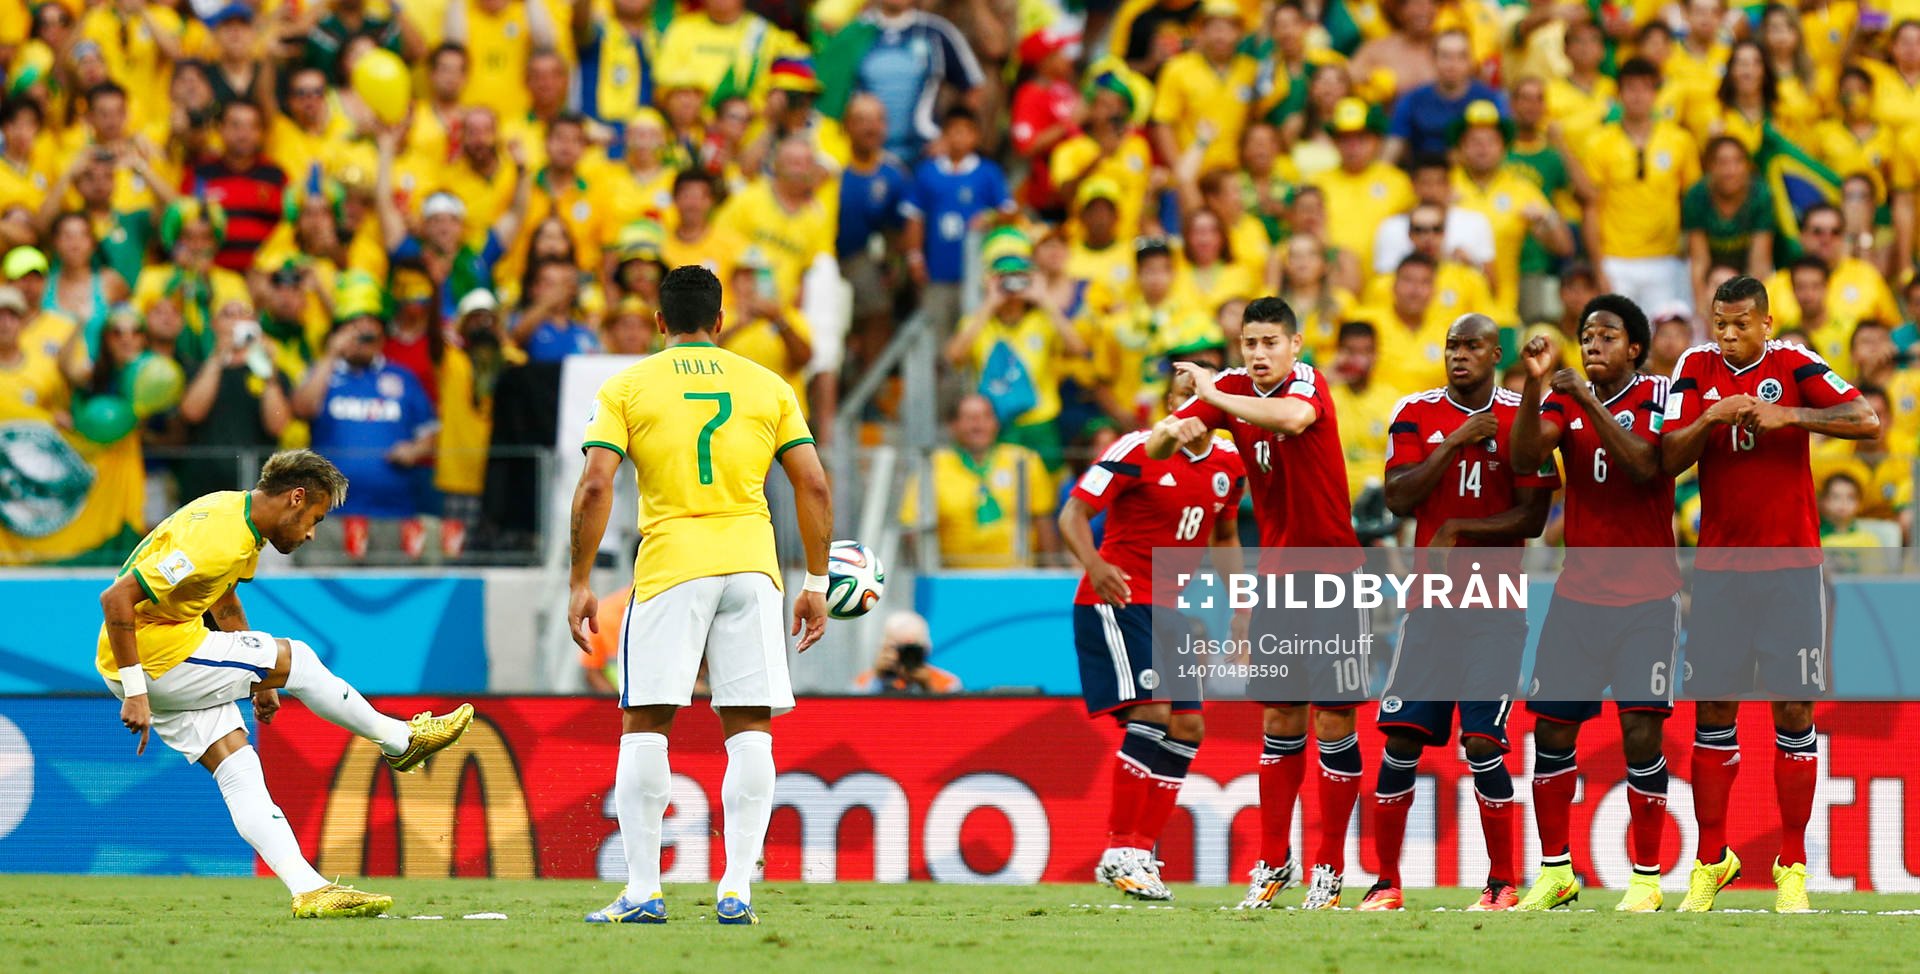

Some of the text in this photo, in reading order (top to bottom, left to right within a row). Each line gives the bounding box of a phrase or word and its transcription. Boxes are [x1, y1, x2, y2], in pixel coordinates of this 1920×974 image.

[672, 358, 724, 375] HULK
[683, 391, 733, 485] 7
[1458, 459, 1482, 498] 14
[1593, 447, 1608, 483] 6
[1175, 506, 1205, 541] 18
[1332, 656, 1360, 694] 10
[1651, 661, 1667, 696] 6
[1797, 647, 1821, 685] 13
[596, 771, 1051, 885] amo
